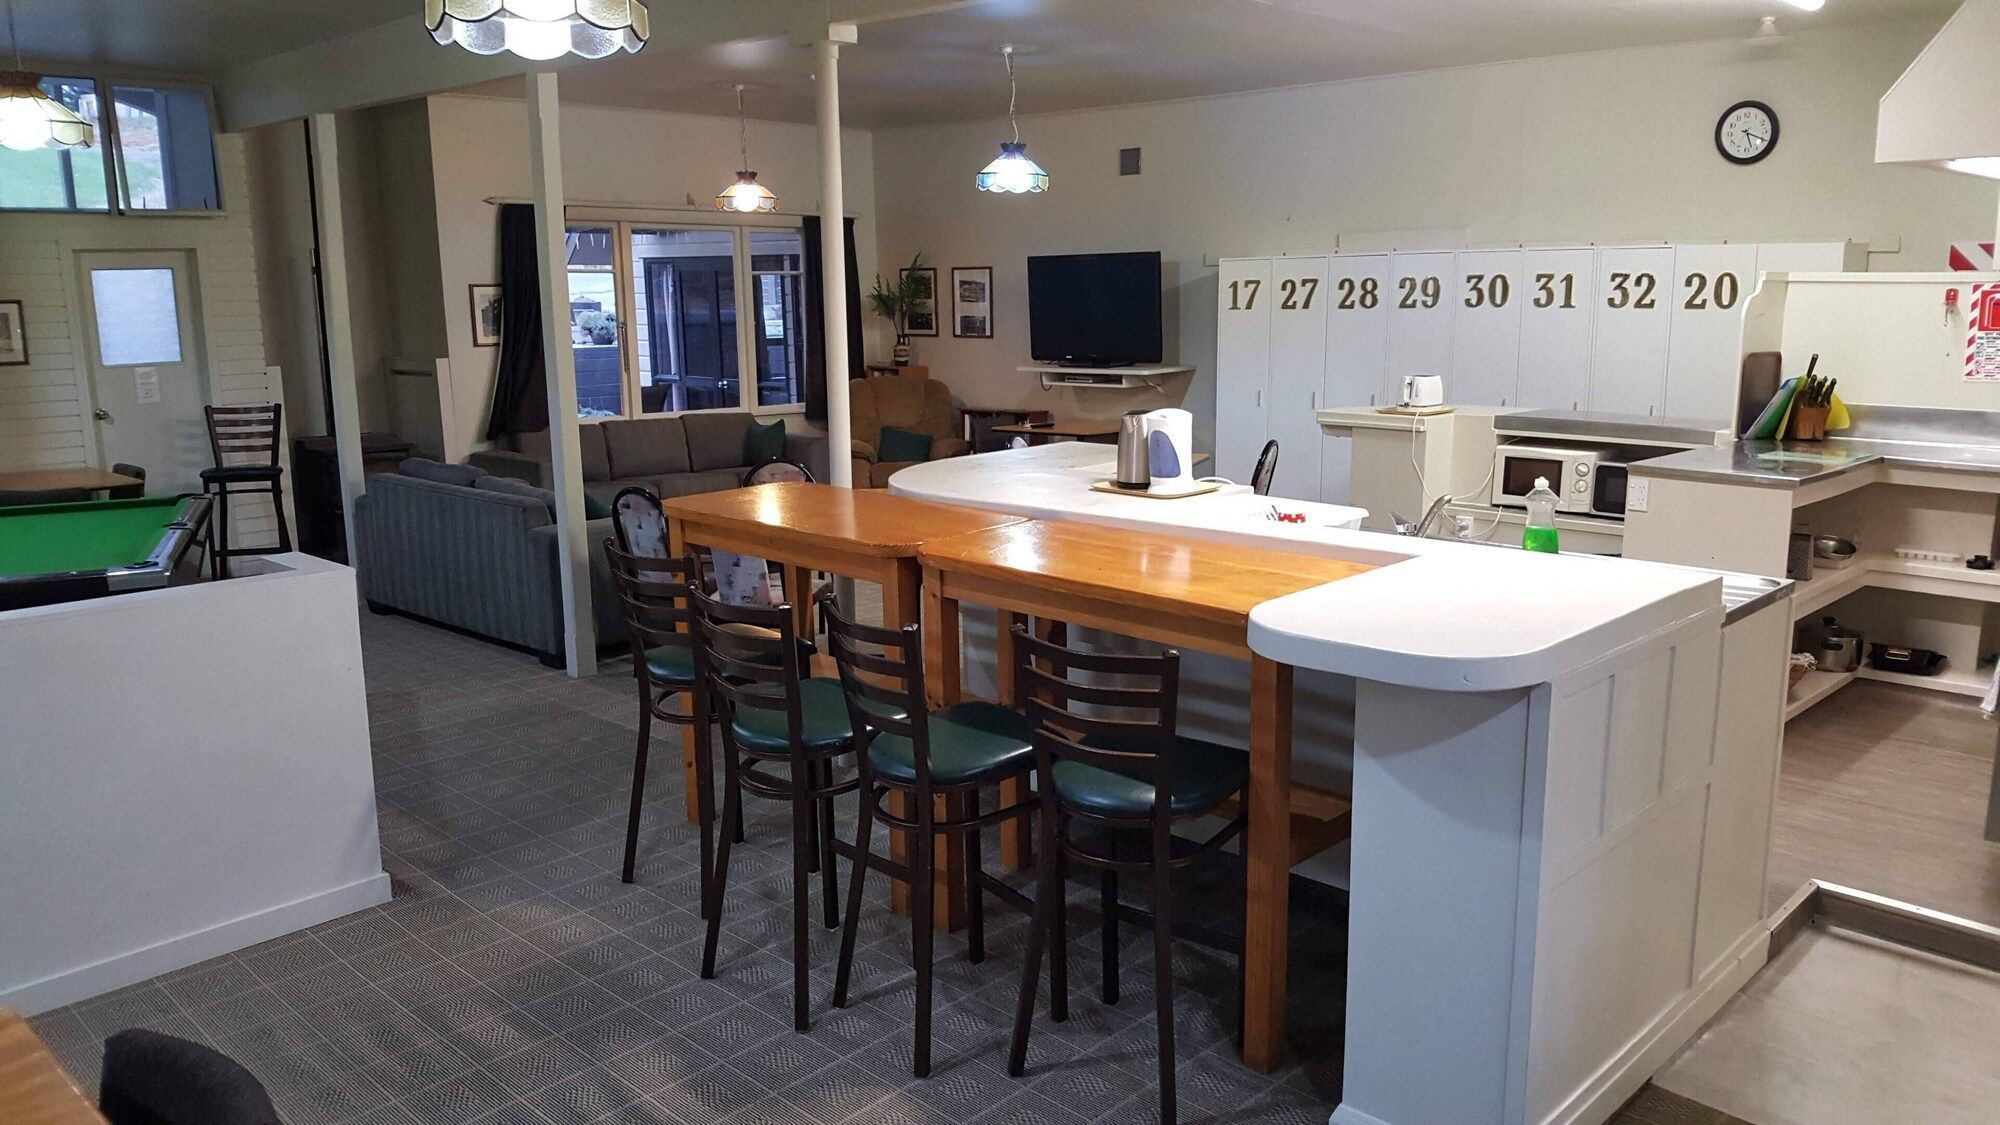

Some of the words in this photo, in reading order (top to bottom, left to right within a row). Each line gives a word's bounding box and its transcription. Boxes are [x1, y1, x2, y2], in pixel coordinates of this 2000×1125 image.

[1228, 279, 1262, 311] 17
[1280, 278, 1319, 310] 27
[1337, 277, 1379, 310] 28
[1398, 276, 1441, 309] 29
[1464, 274, 1510, 309] 30
[1533, 273, 1576, 309] 31
[1607, 272, 1656, 309] 32
[1684, 272, 1739, 310] 20
